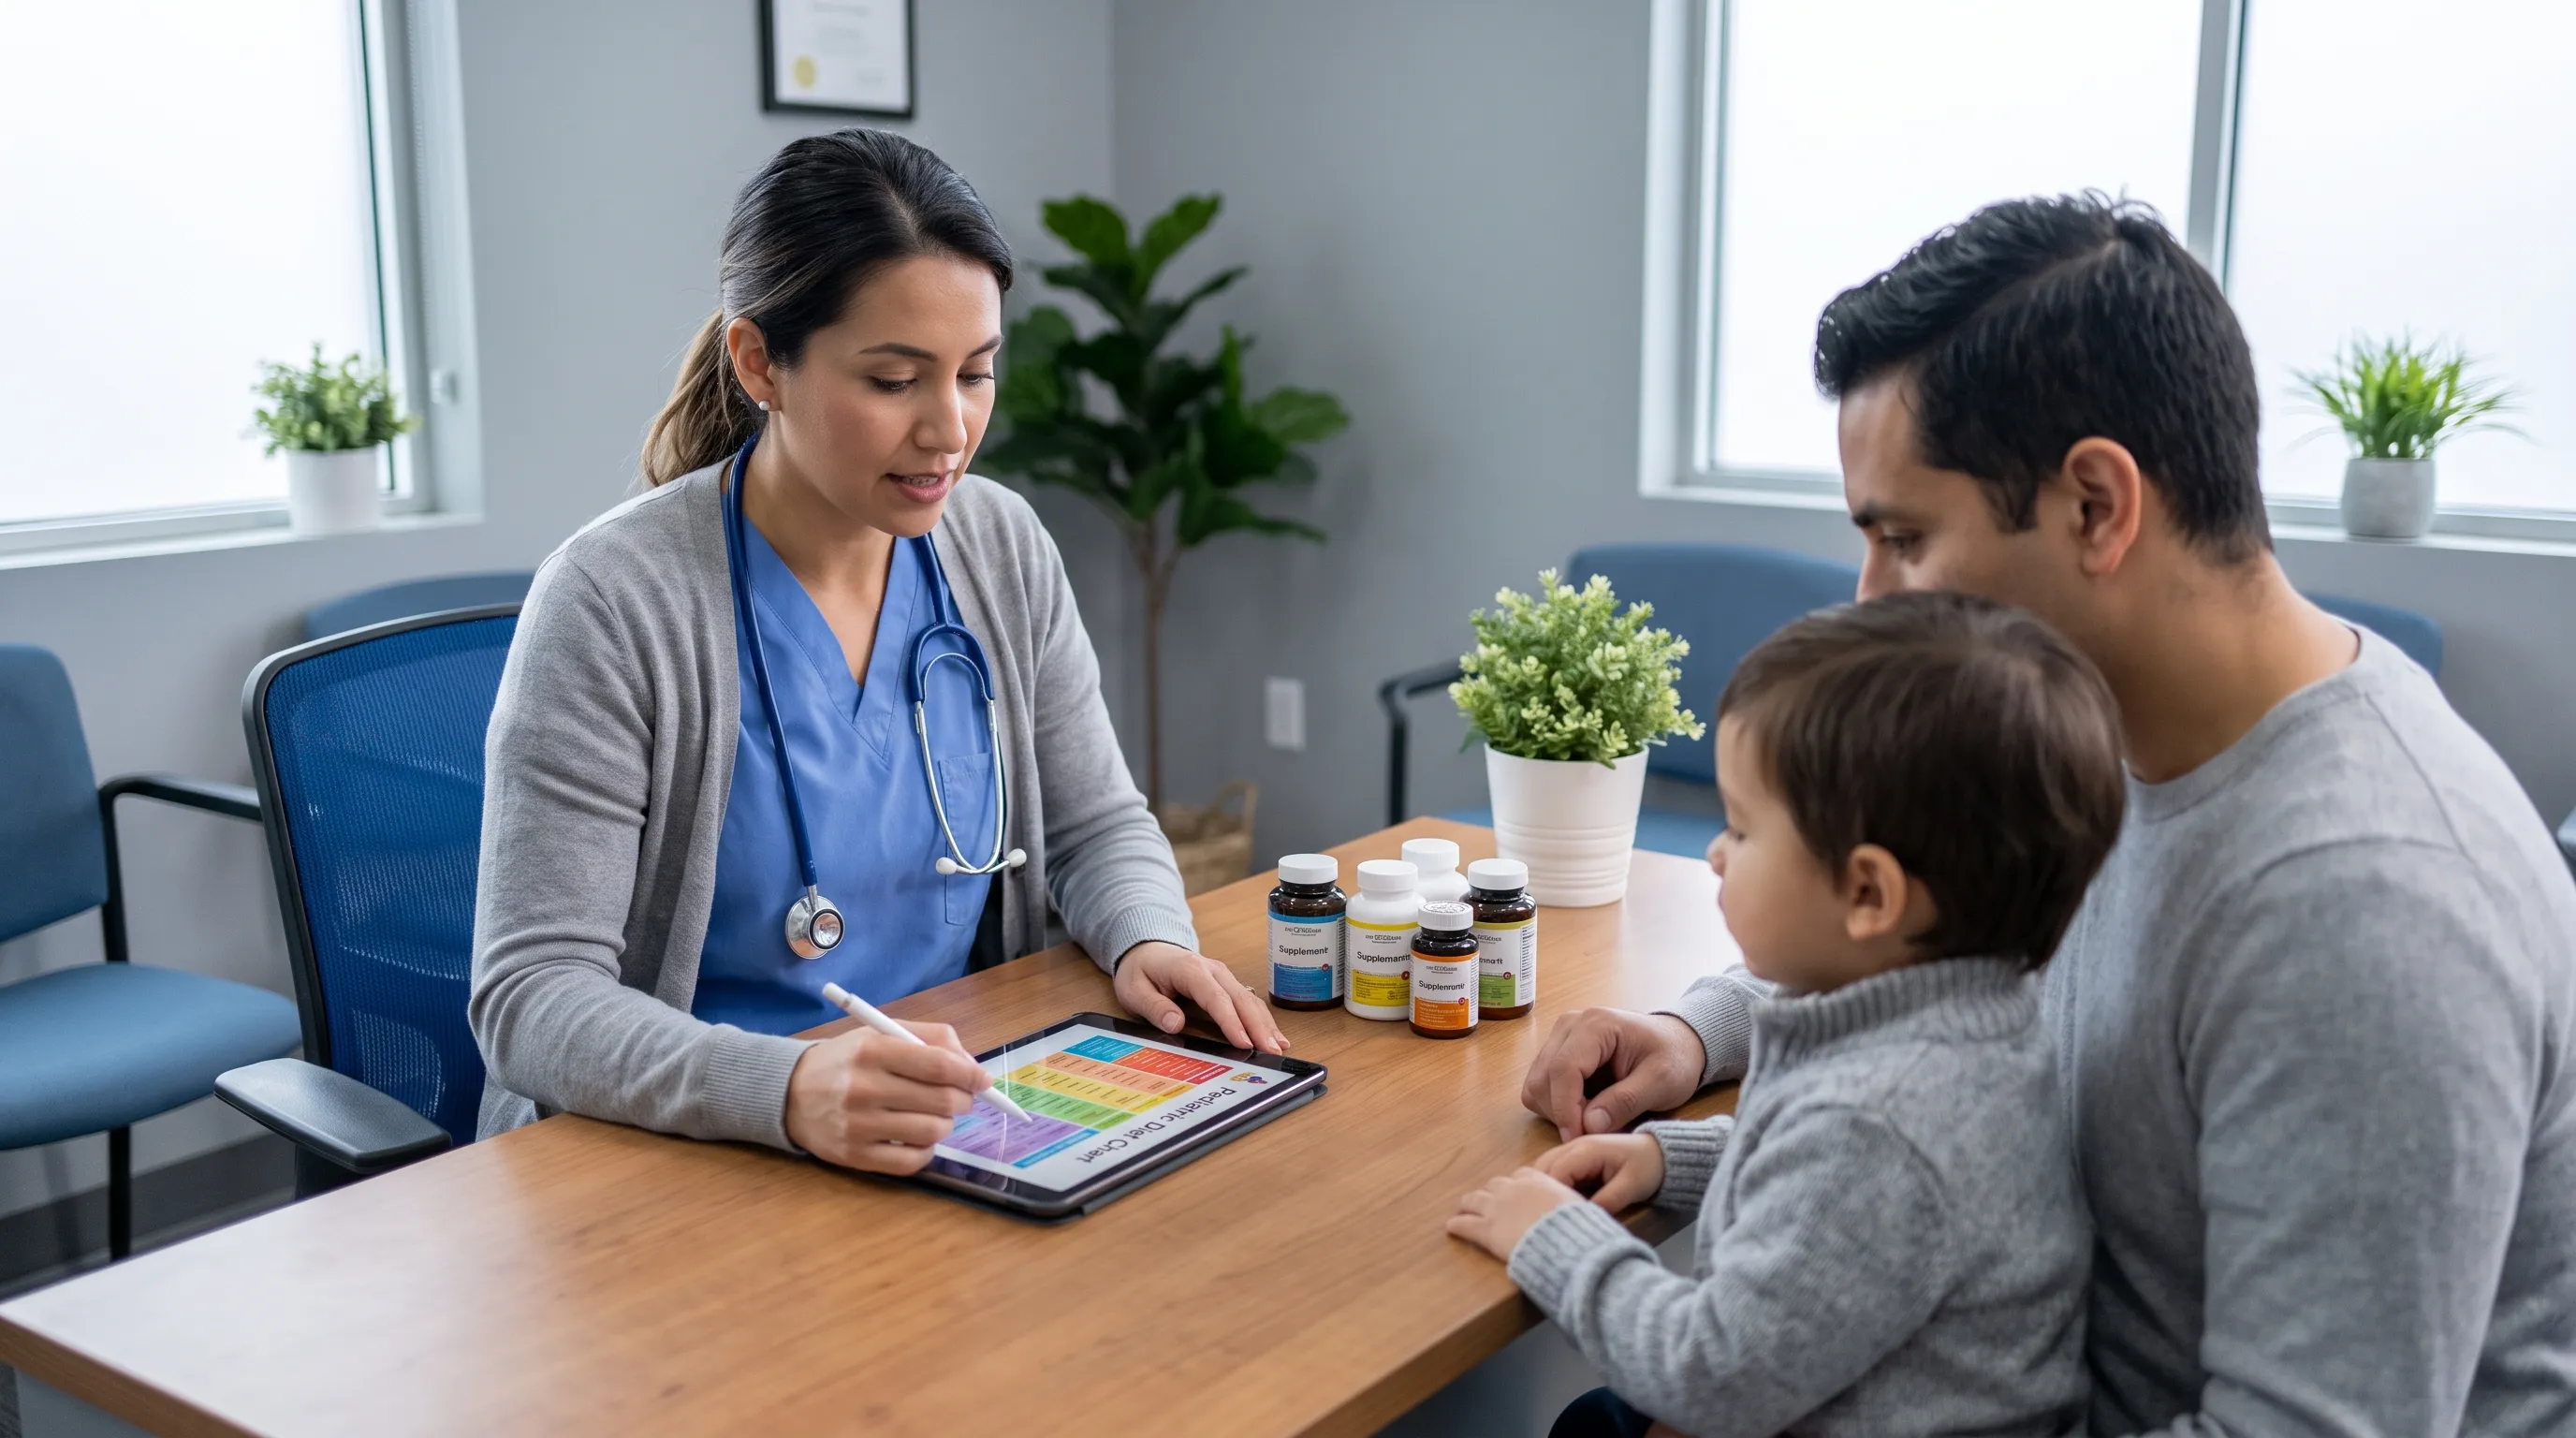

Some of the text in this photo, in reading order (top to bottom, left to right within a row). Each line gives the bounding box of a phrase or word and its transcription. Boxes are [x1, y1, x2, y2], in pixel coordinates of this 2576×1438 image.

[1160, 1086, 1237, 1123] Pediatric
[1124, 1121, 1166, 1140] Diet
[1076, 1138, 1128, 1164] Chart
